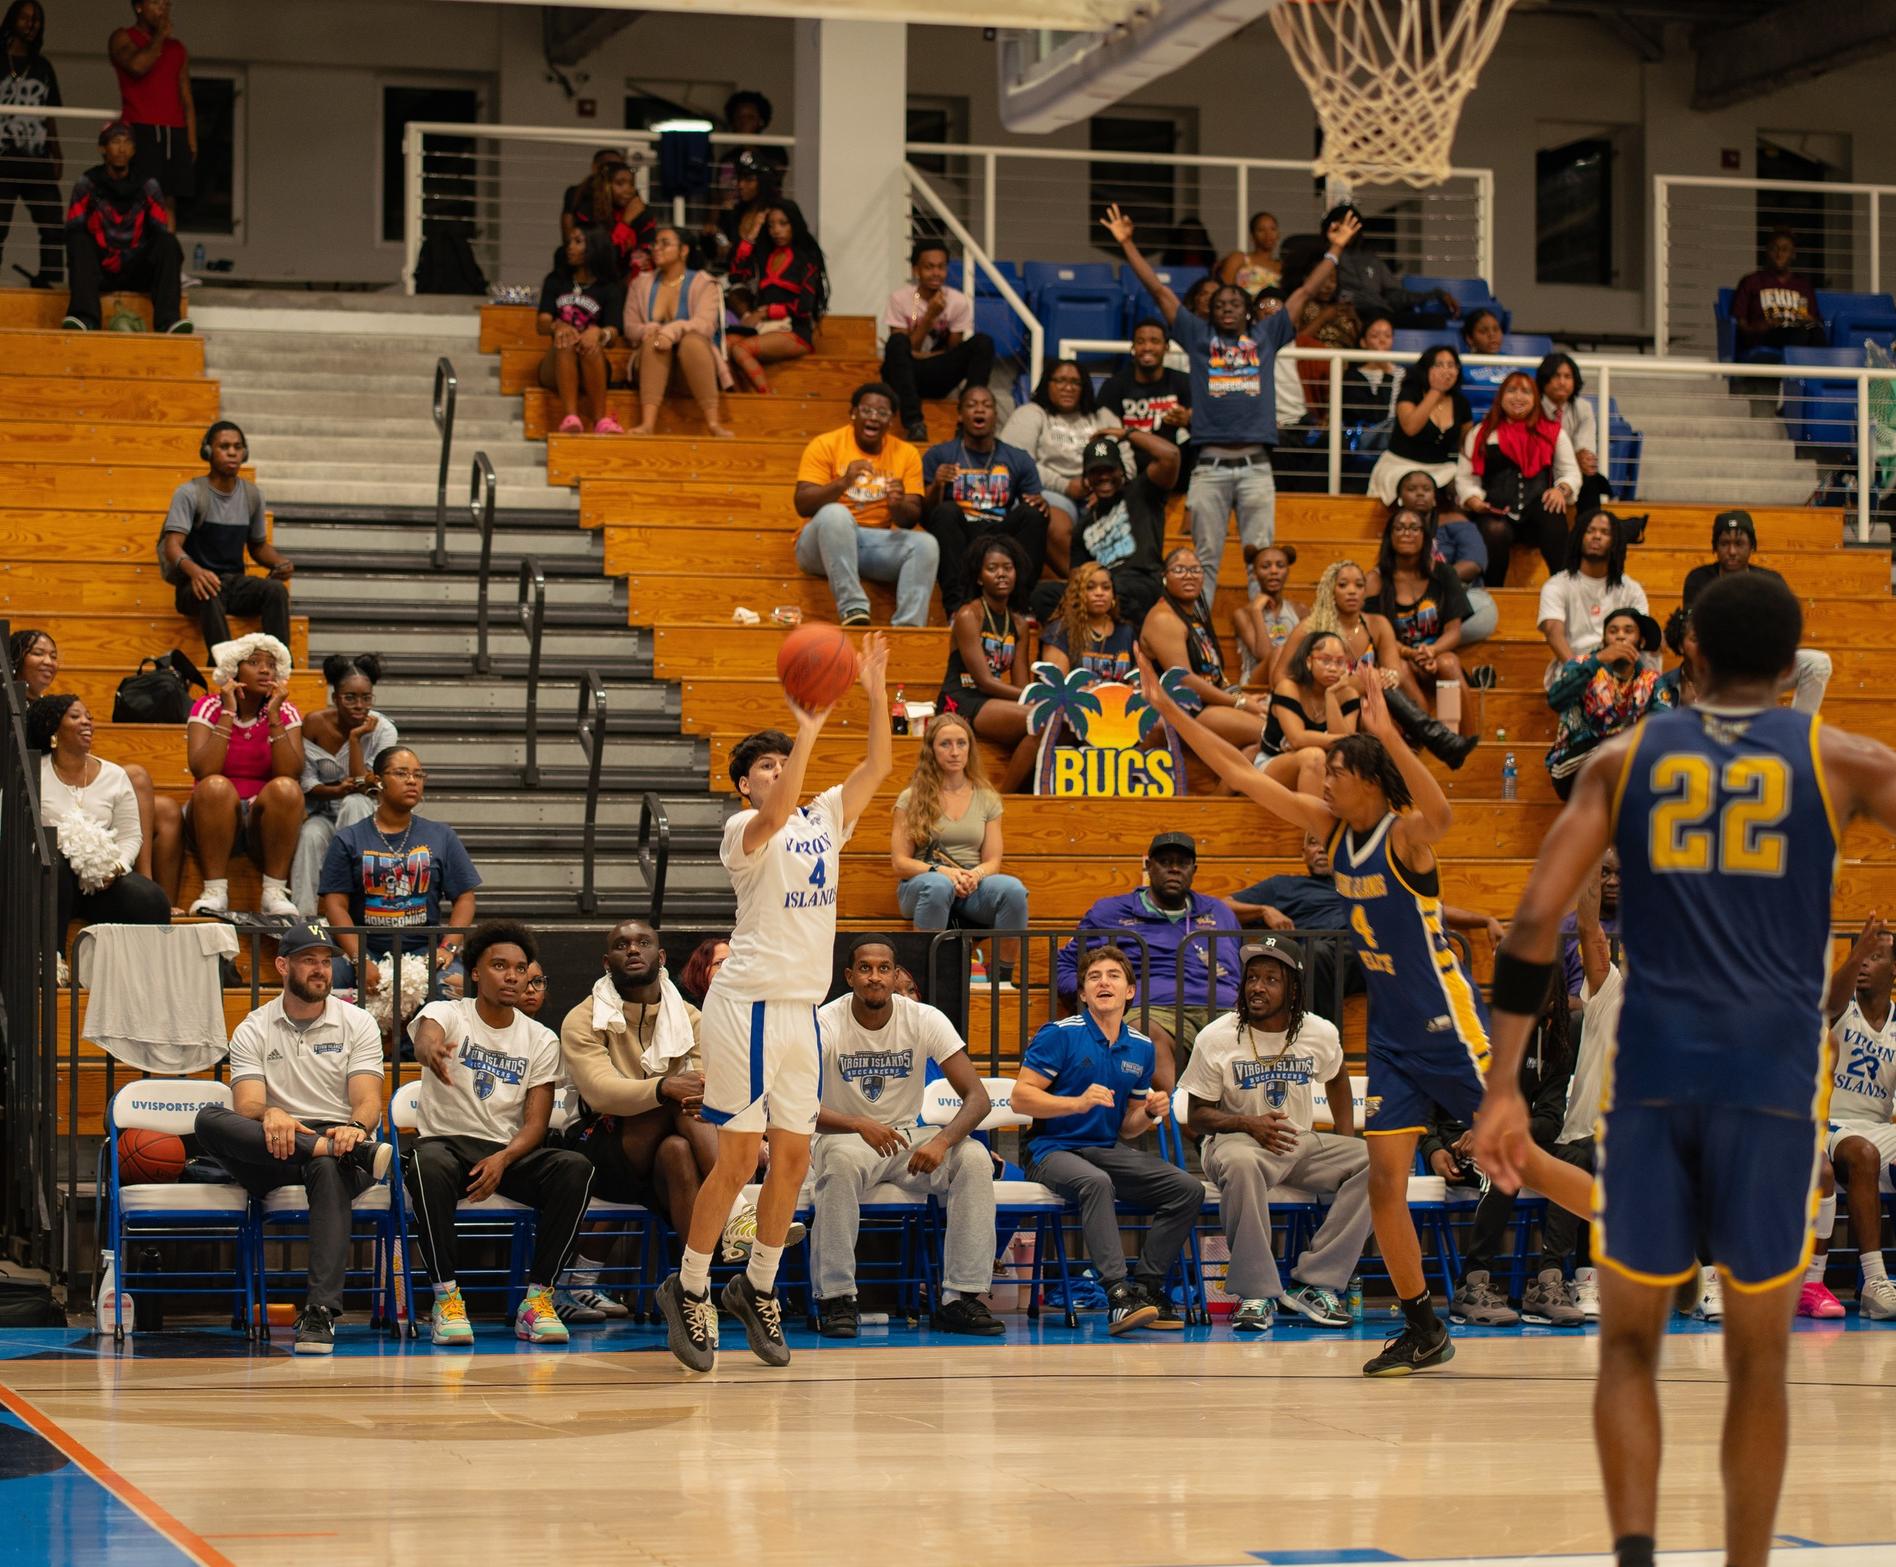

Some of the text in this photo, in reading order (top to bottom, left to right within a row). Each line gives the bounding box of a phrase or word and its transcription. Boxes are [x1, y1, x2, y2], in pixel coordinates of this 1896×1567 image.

[1055, 749, 1174, 797] BUCS
[1649, 752, 1792, 877] 22
[809, 857, 826, 889] 4
[364, 912, 428, 927] HOMECOMING
[485, 1053, 526, 1076] ISLANDS
[839, 1052, 911, 1072] VIRGIN ISLANDS
[1272, 1059, 1313, 1075] ISLANDS
[1249, 1074, 1303, 1083] BUCCANEERS
